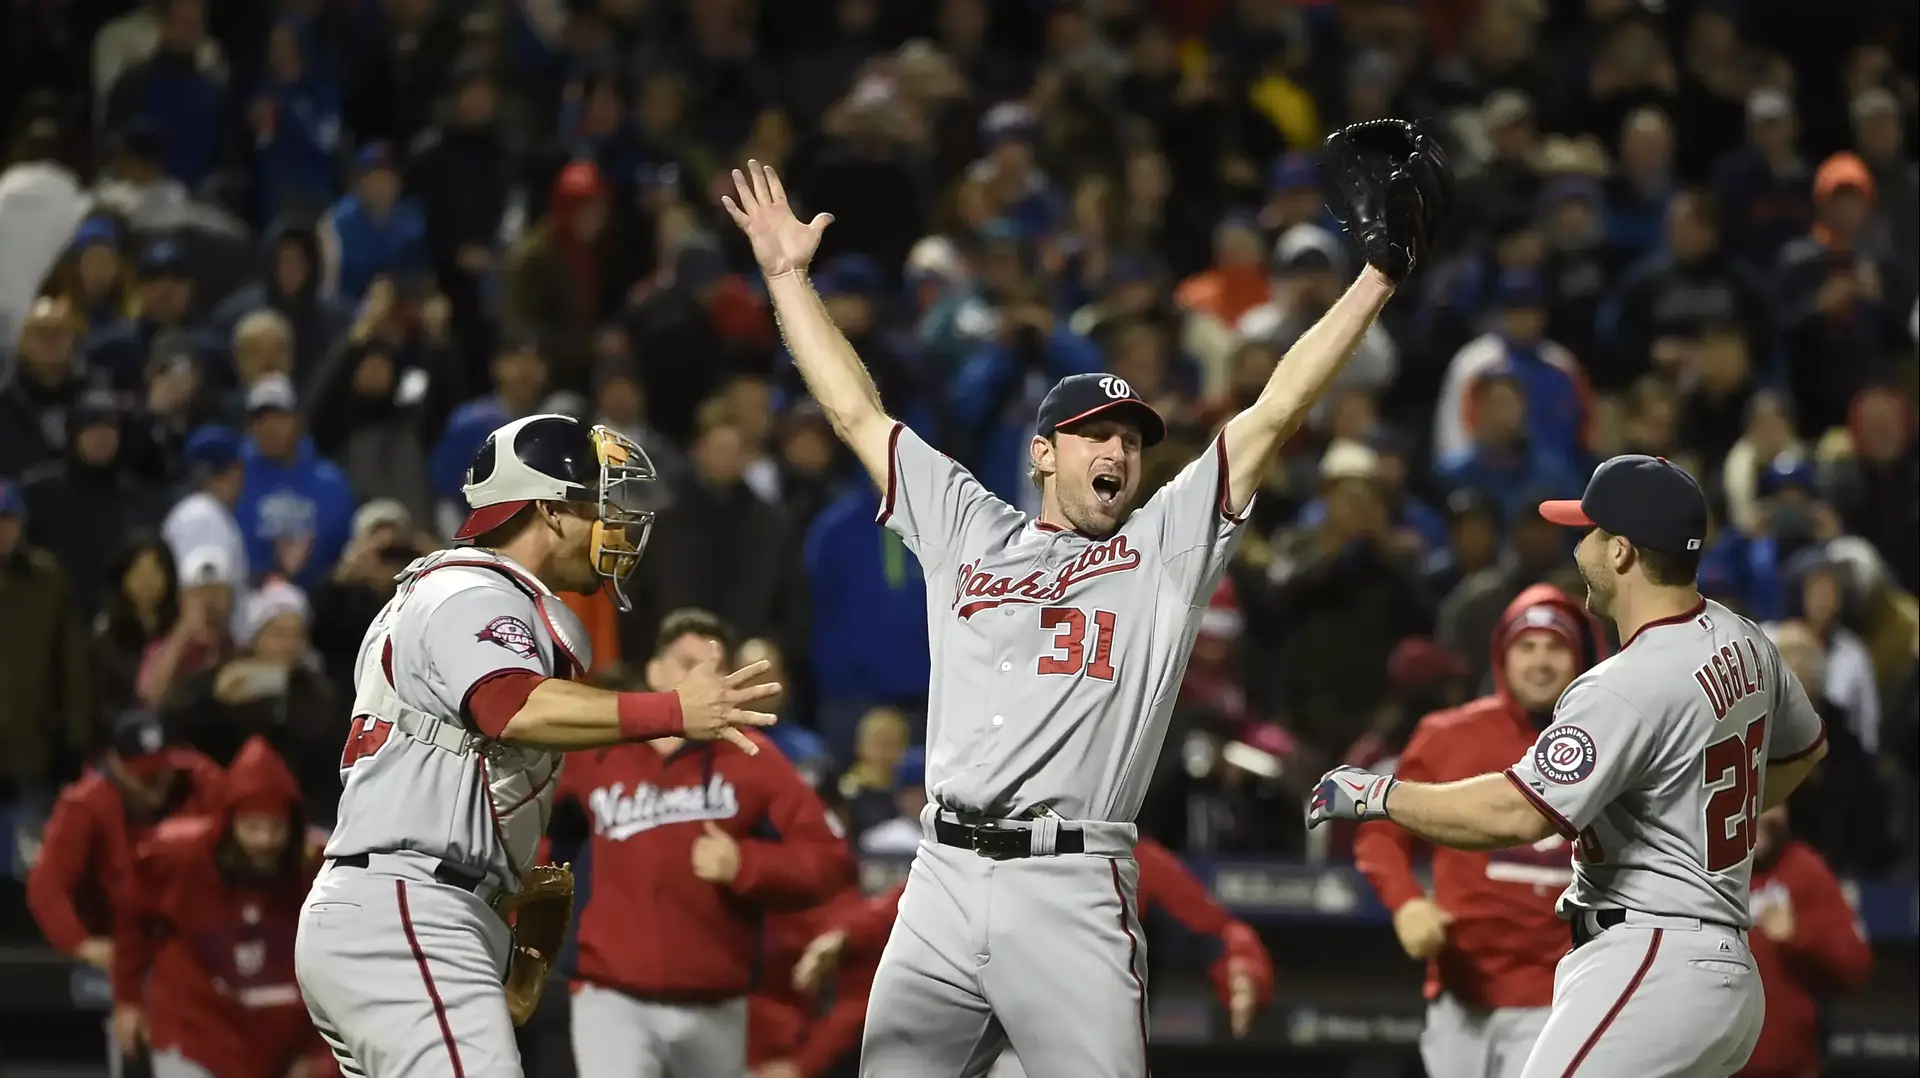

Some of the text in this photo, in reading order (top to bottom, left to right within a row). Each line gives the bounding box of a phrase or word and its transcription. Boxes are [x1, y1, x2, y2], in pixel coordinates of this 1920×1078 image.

[1099, 376, 1131, 399] W
[951, 534, 1141, 616] Washigton
[1036, 605, 1119, 684] 31
[1693, 635, 1766, 723] UGGLA
[1537, 752, 1581, 782] NATIONALS
[1546, 727, 1594, 763] WASHINGTON
[1702, 712, 1767, 873] 26
